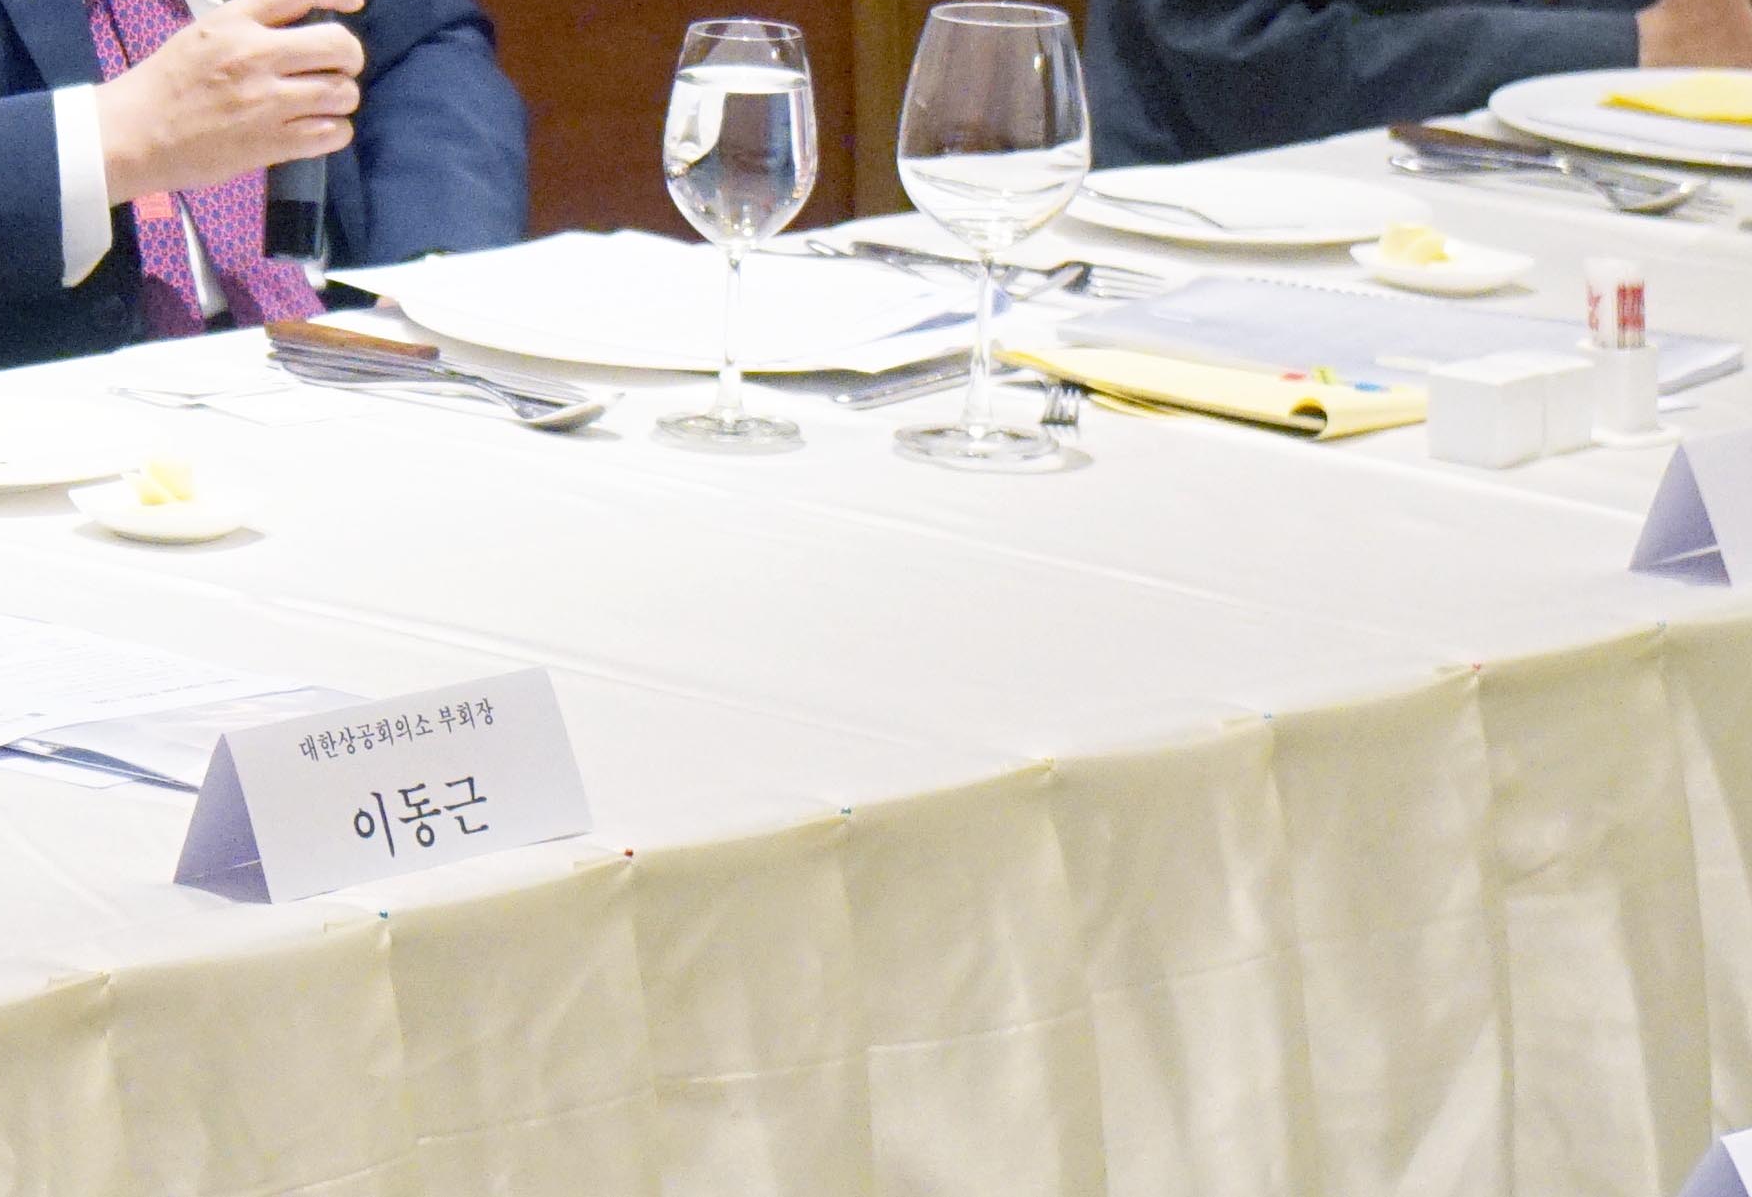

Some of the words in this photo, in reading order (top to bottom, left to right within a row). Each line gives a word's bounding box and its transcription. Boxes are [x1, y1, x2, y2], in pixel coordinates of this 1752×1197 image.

[299, 714, 434, 761] 대한상공회의소
[438, 698, 494, 734] 부회장
[353, 776, 489, 857] 이동근
